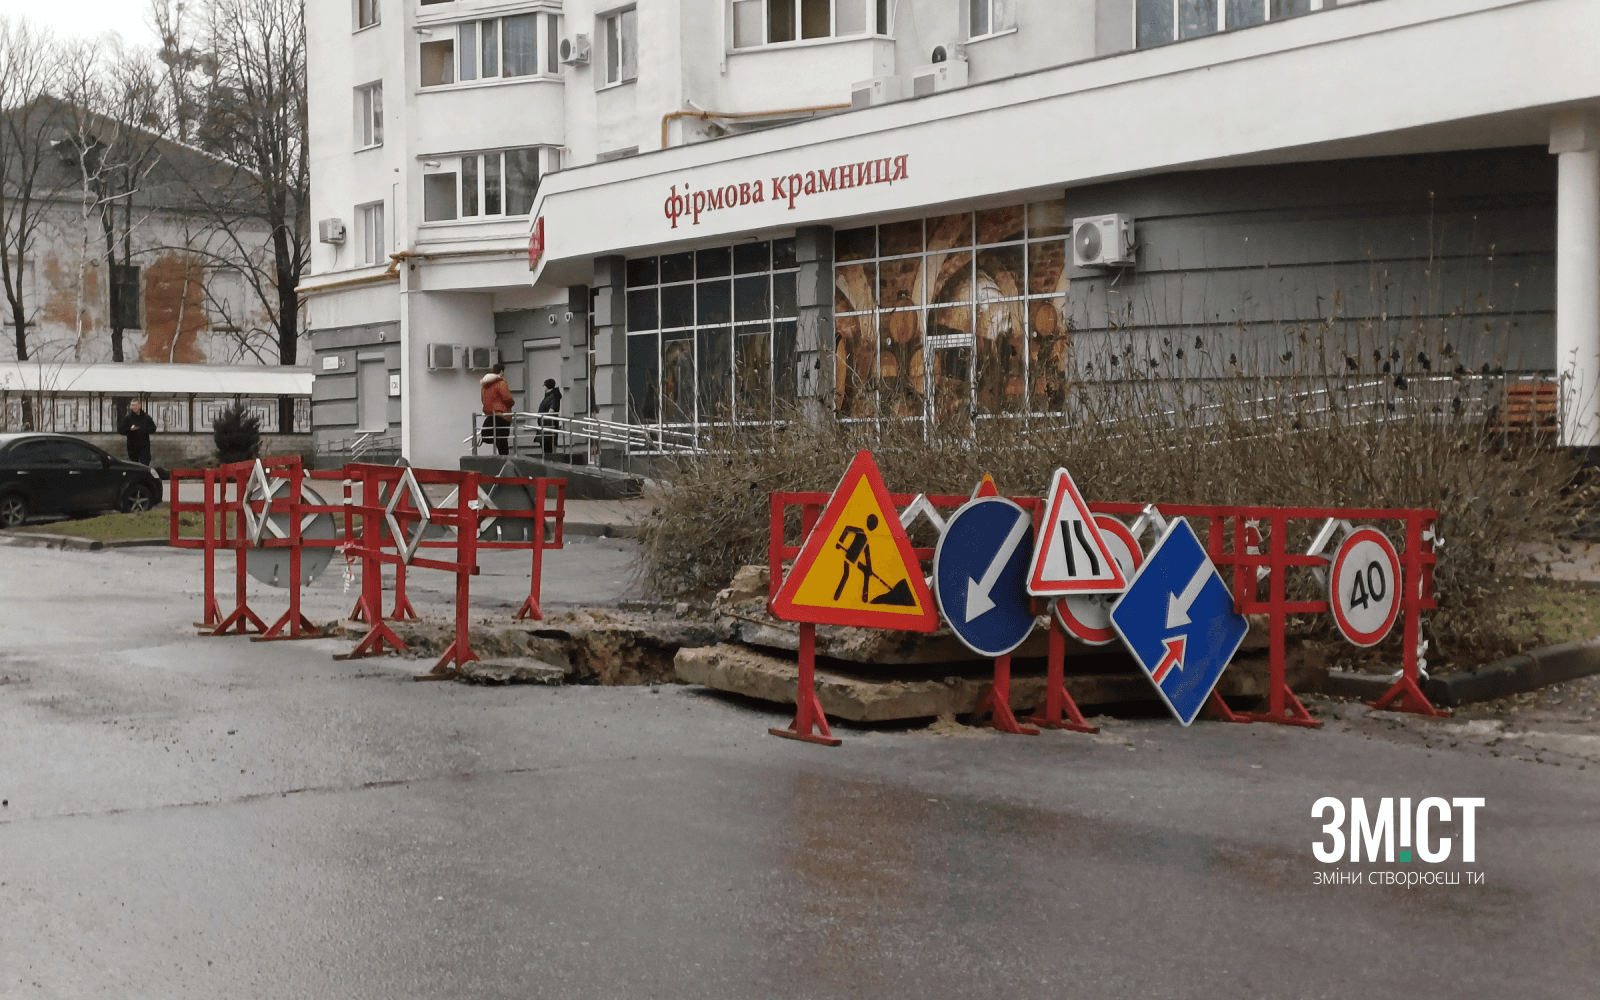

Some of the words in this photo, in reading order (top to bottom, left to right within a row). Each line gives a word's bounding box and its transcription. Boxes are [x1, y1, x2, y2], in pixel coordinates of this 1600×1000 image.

[664, 179, 765, 229] фірмова
[771, 154, 909, 210] крамниця
[1350, 560, 1387, 610] 40
